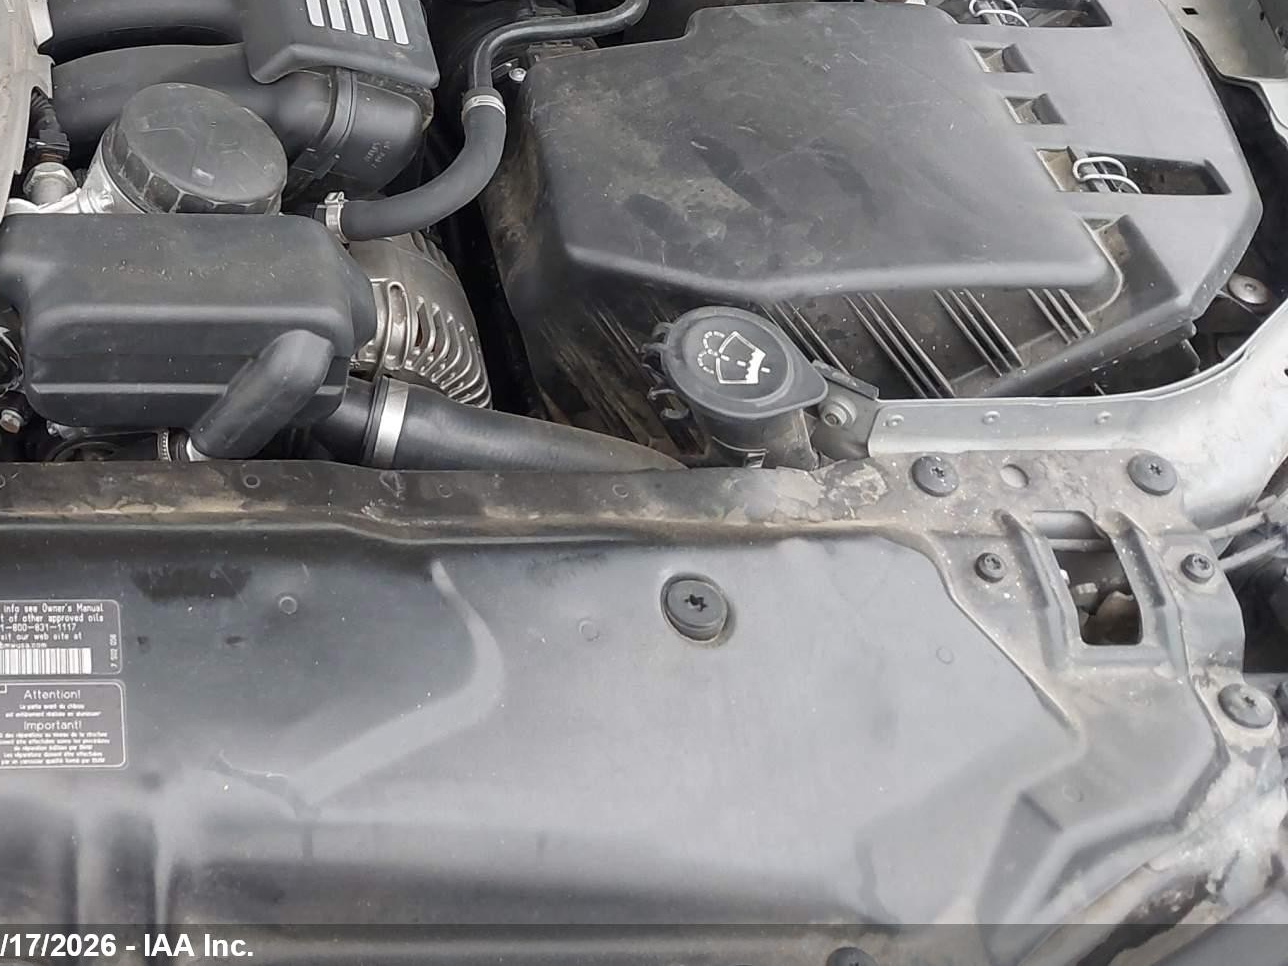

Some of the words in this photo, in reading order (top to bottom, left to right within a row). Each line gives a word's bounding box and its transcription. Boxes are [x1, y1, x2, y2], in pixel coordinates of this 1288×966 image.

[4, 604, 19, 613] info
[24, 605, 37, 613] see
[42, 603, 72, 613] Owner's
[77, 603, 104, 612] Manual
[9, 614, 18, 623] of
[23, 614, 43, 622] other
[48, 613, 83, 623] approved
[88, 613, 104, 622] oils
[24, 690, 81, 700] Attention!
[24, 721, 81, 731] Important!
